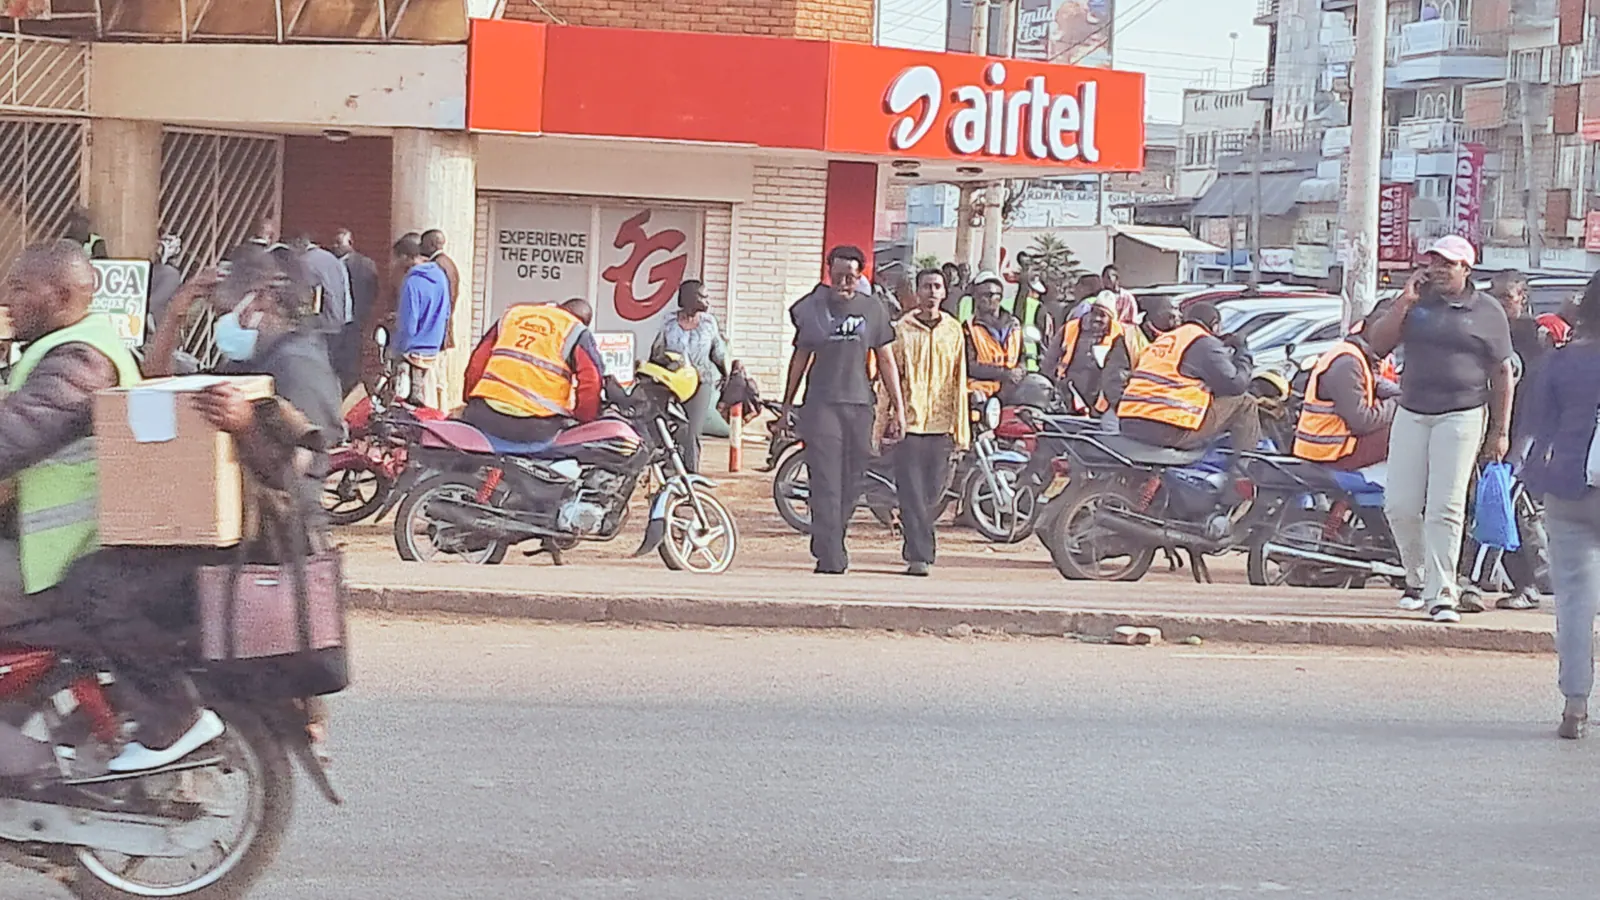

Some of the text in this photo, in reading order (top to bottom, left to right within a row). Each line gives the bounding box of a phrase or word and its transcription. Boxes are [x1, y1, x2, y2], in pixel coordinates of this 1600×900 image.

[948, 62, 1099, 163] airtel
[1380, 186, 1394, 246] KIMSA
[500, 230, 587, 248] EXPERIENCE
[501, 247, 584, 264] THE POWER
[517, 264, 561, 280] OF 5G
[602, 208, 688, 322] 5G
[515, 333, 536, 350] 27
